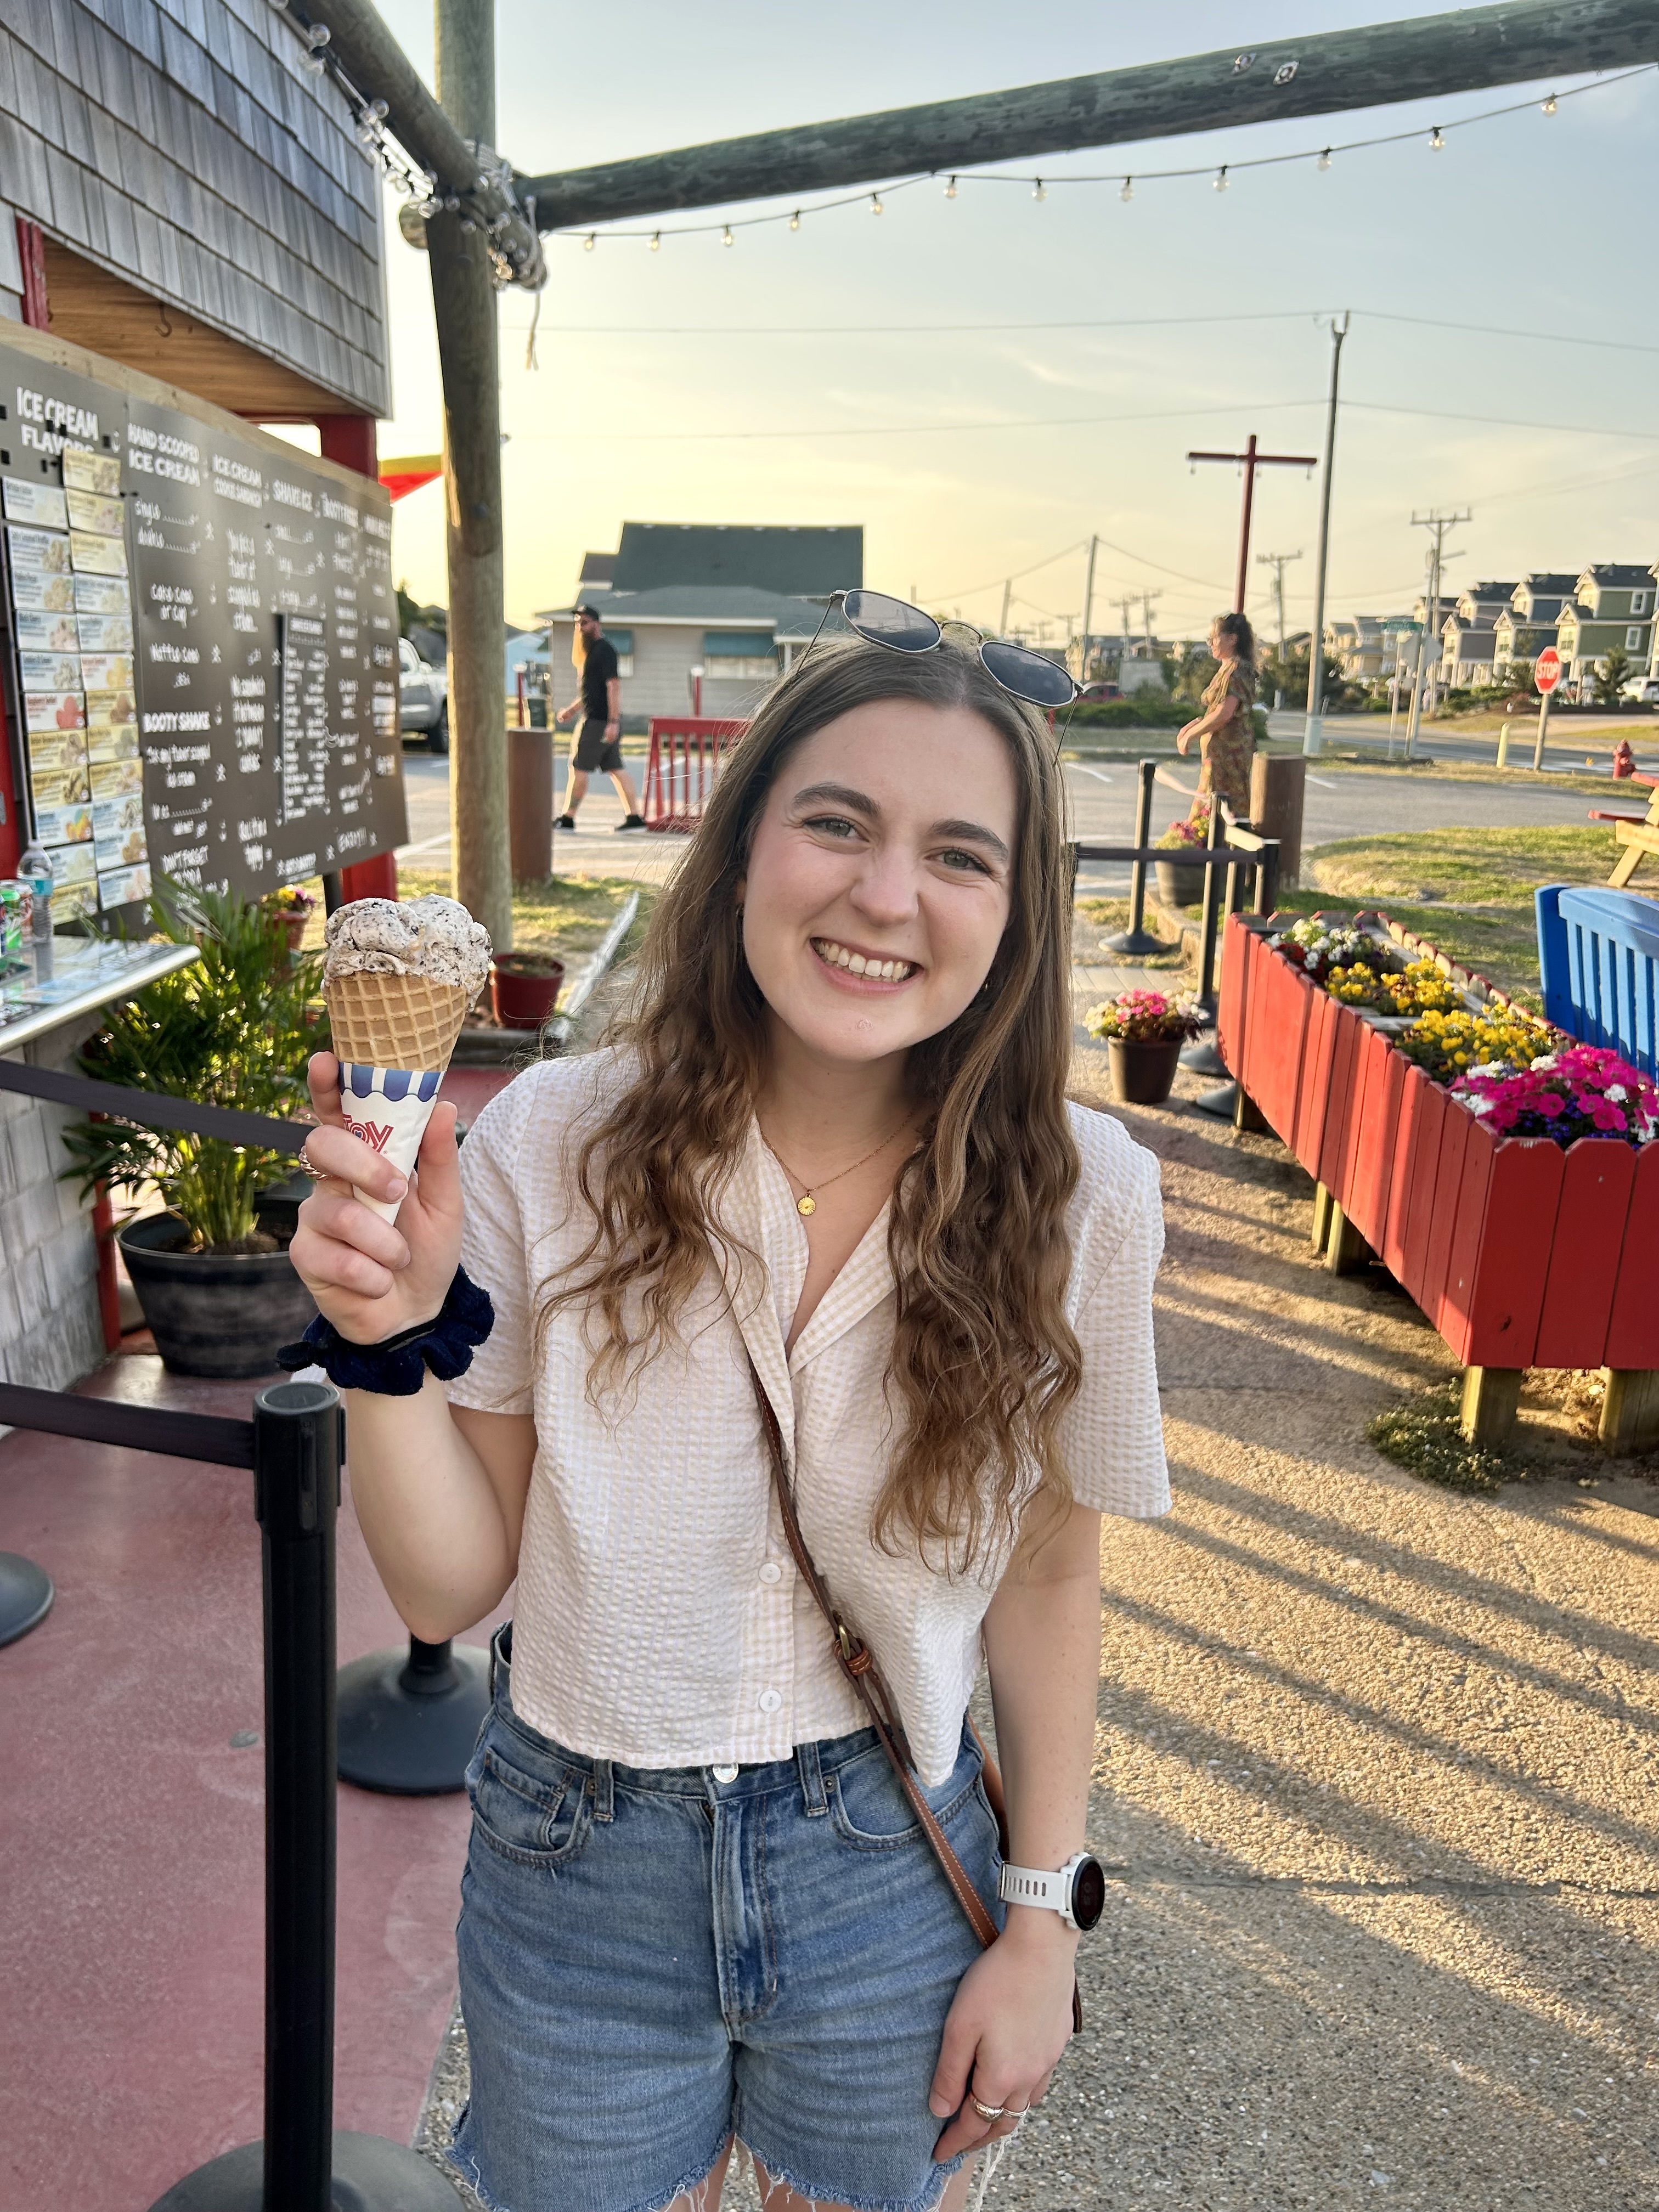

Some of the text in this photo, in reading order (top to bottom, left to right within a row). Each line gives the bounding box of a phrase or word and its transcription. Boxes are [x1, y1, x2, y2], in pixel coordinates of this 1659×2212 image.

[16, 386, 99, 441] ICE CREAM
[127, 422, 200, 464] HAND SCOOPED
[128, 449, 154, 474] ICE
[154, 457, 201, 488] CREAM
[212, 454, 262, 489] ICE CREAM
[1537, 661, 1559, 680] STOP
[144, 711, 210, 733] BOOTY SHAKE
